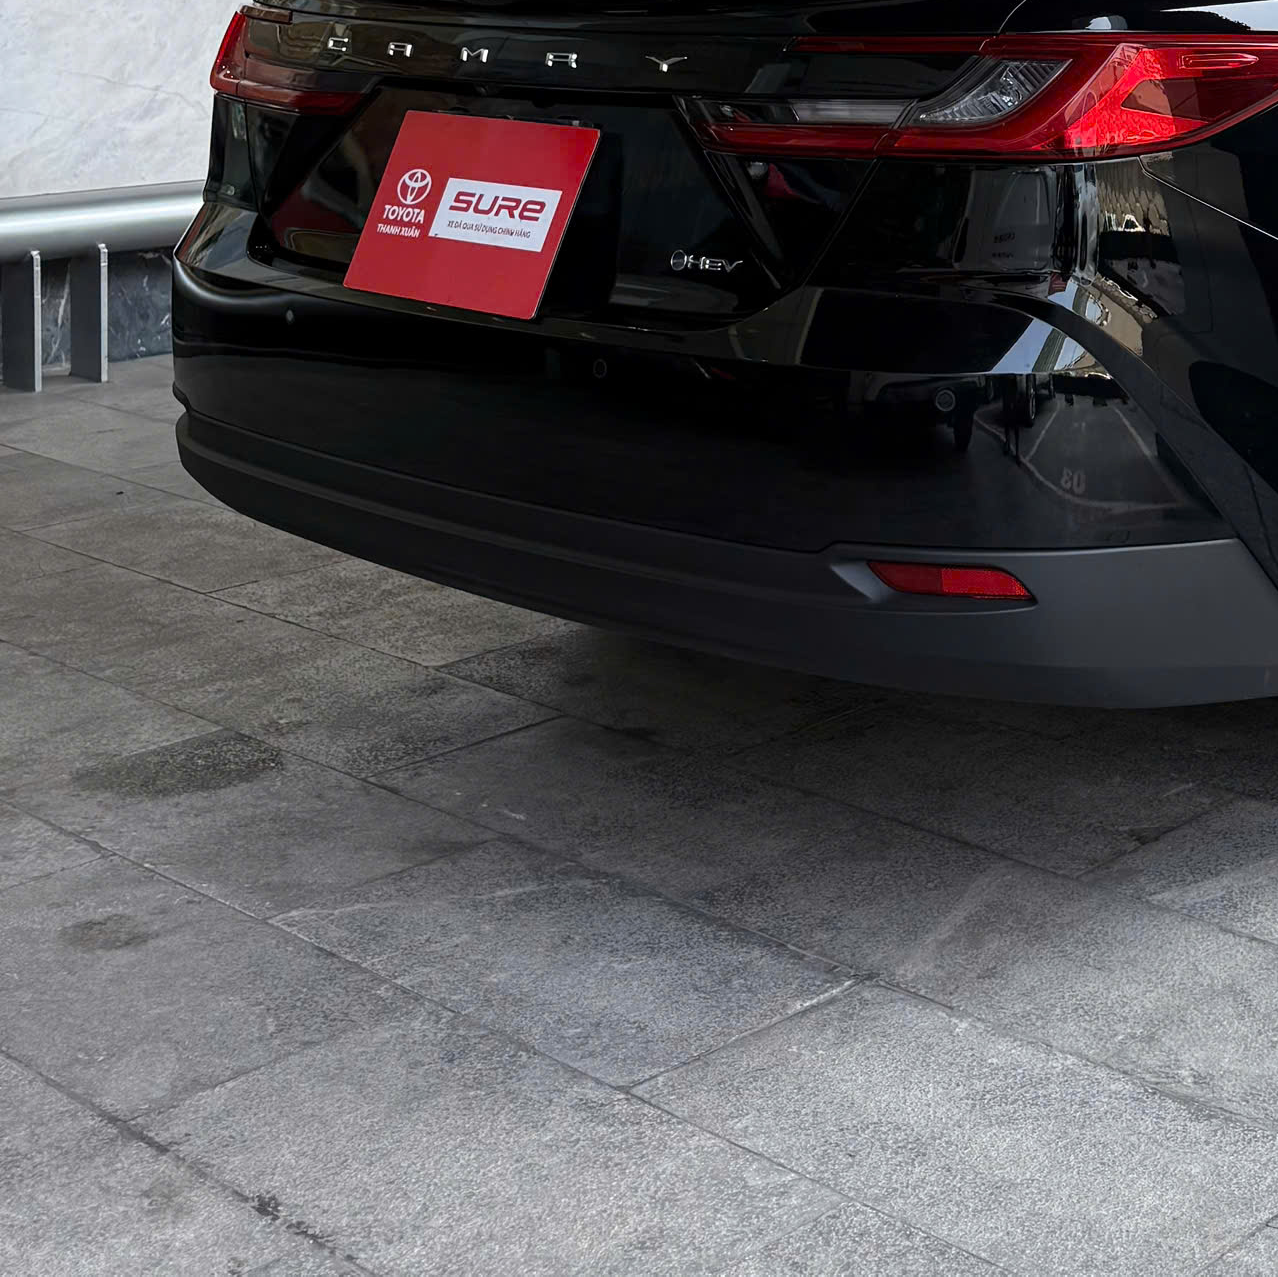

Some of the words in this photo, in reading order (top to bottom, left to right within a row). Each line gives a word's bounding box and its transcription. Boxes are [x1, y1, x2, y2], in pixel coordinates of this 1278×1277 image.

[329, 36, 688, 73] CAMRY
[383, 205, 425, 224] TOYOTA
[376, 223, 400, 235] THANH
[400, 225, 421, 238] XUÂN
